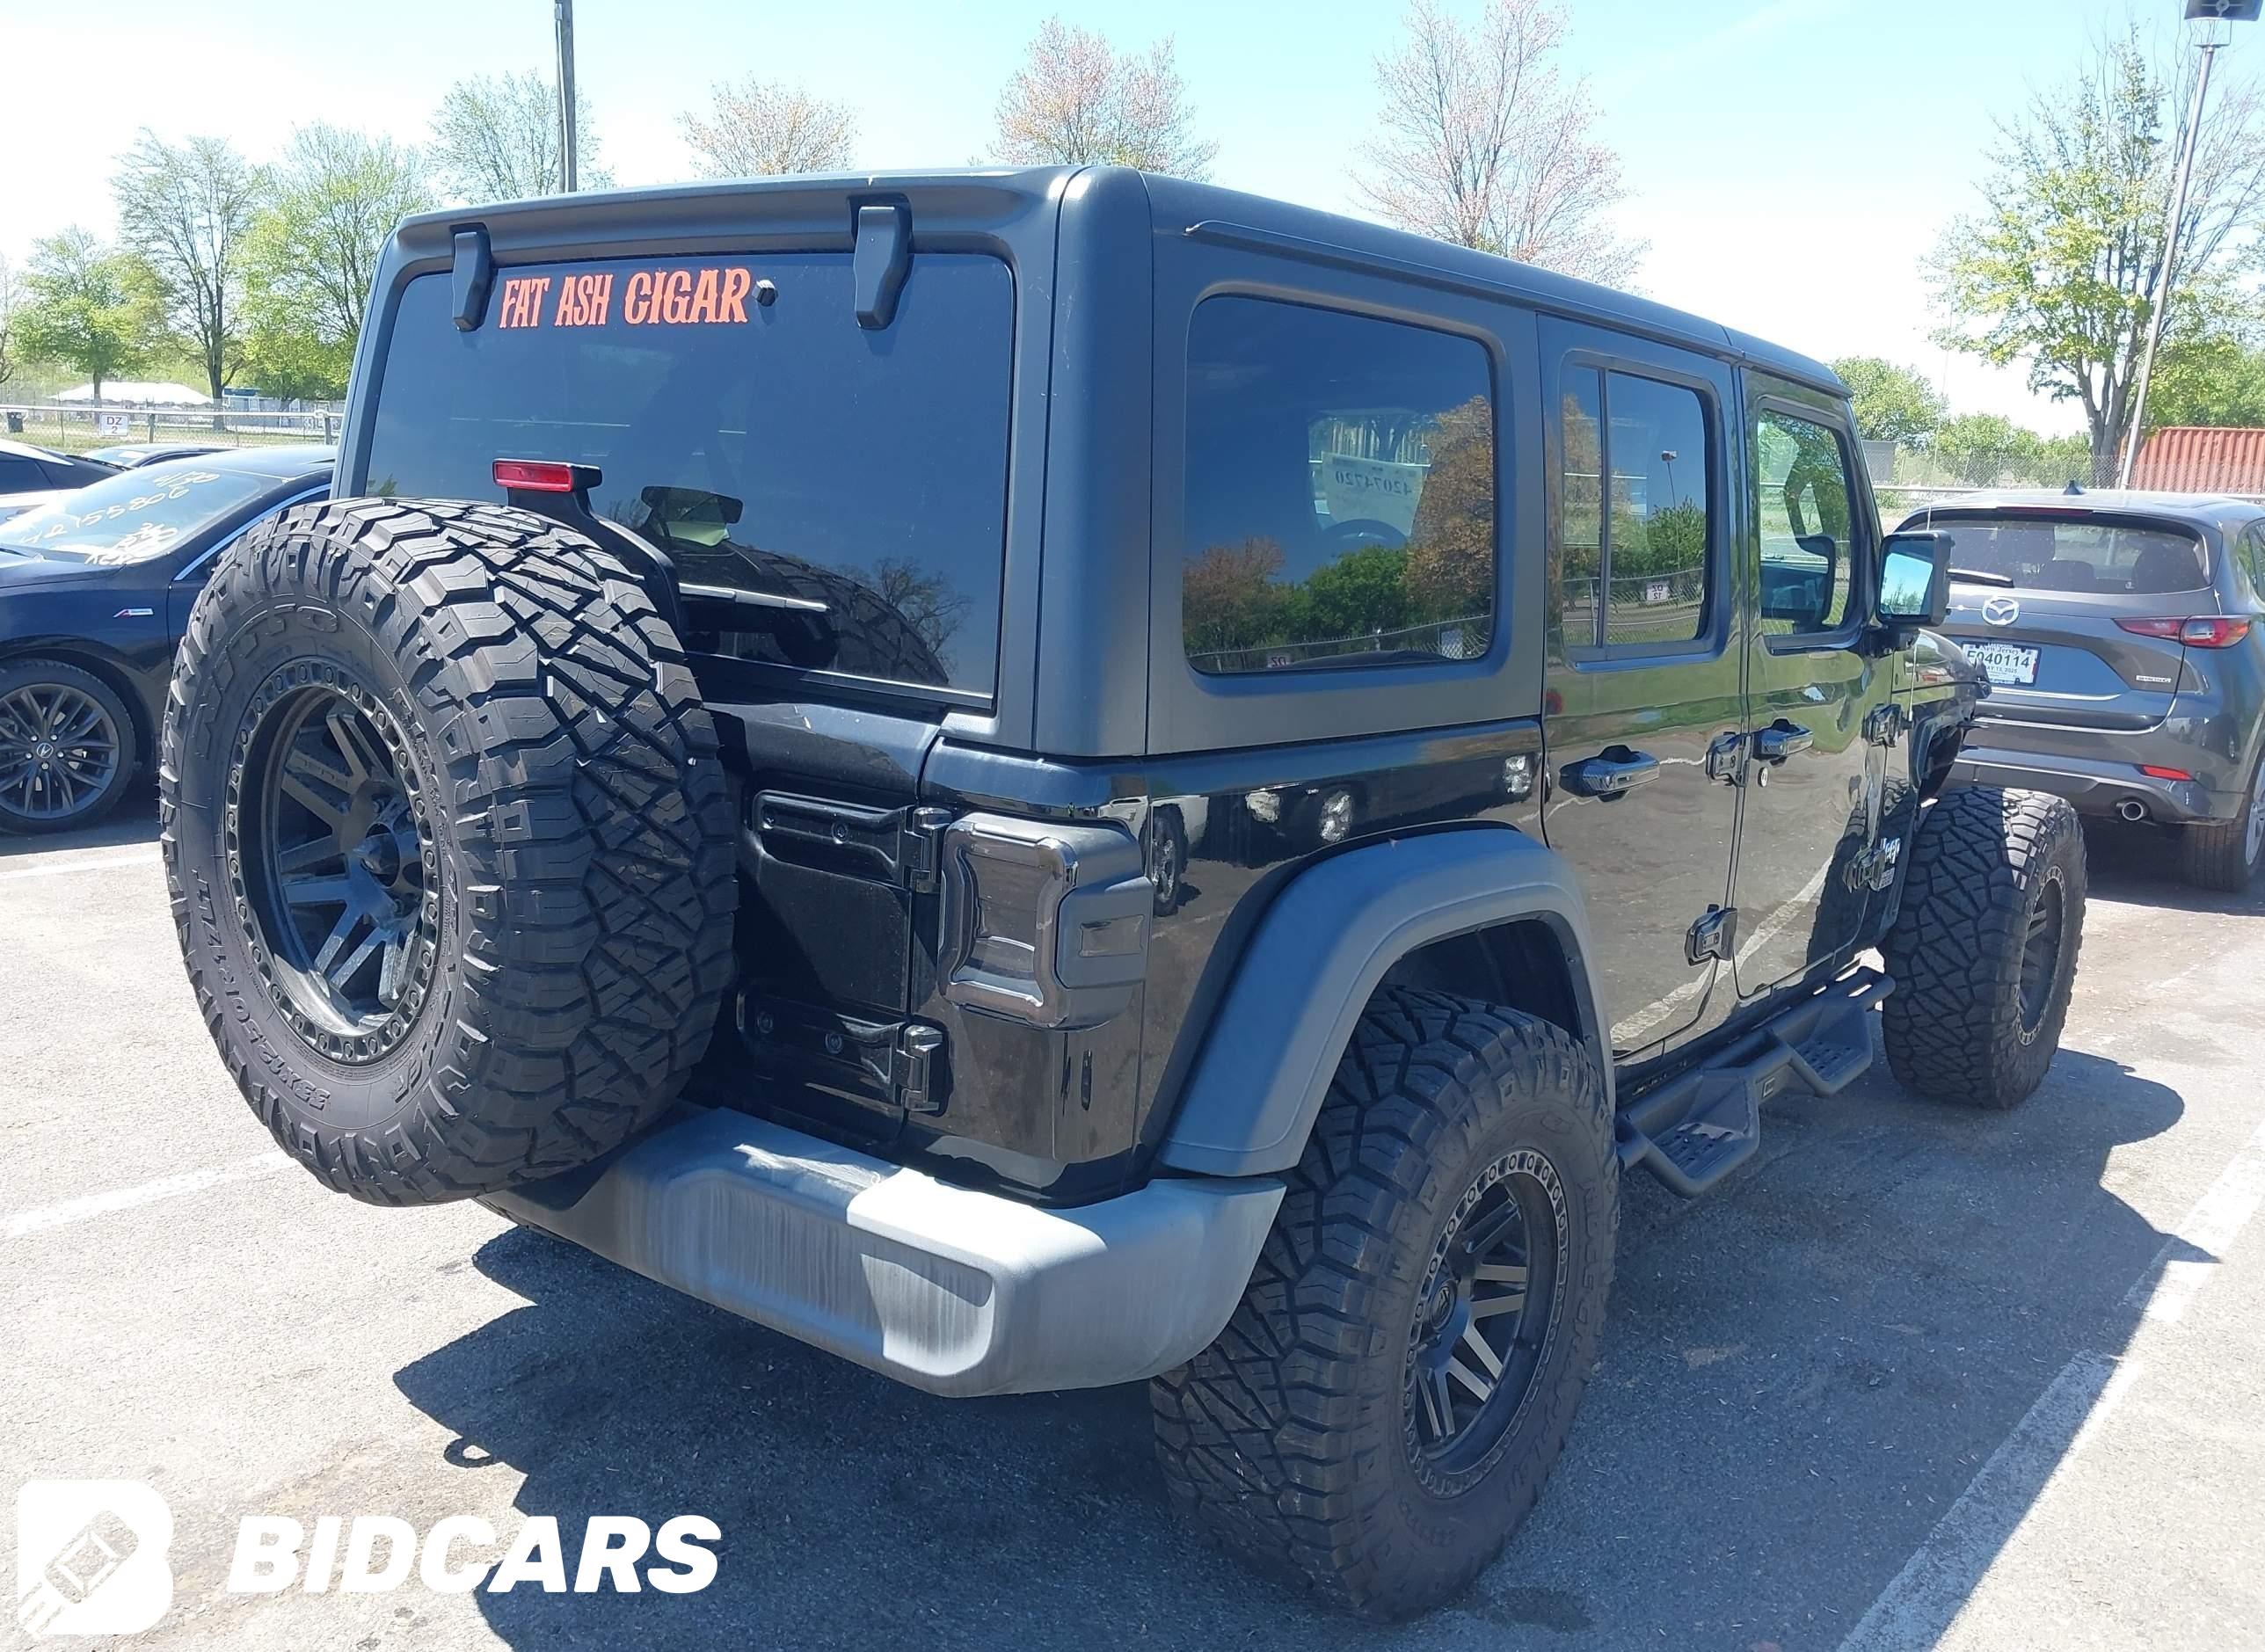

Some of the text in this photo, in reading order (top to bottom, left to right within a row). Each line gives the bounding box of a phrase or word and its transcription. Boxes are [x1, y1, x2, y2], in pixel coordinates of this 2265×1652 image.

[498, 267, 752, 329] FAT ASH CIGAR
[106, 416, 123, 426] DZ
[112, 426, 119, 434] 2
